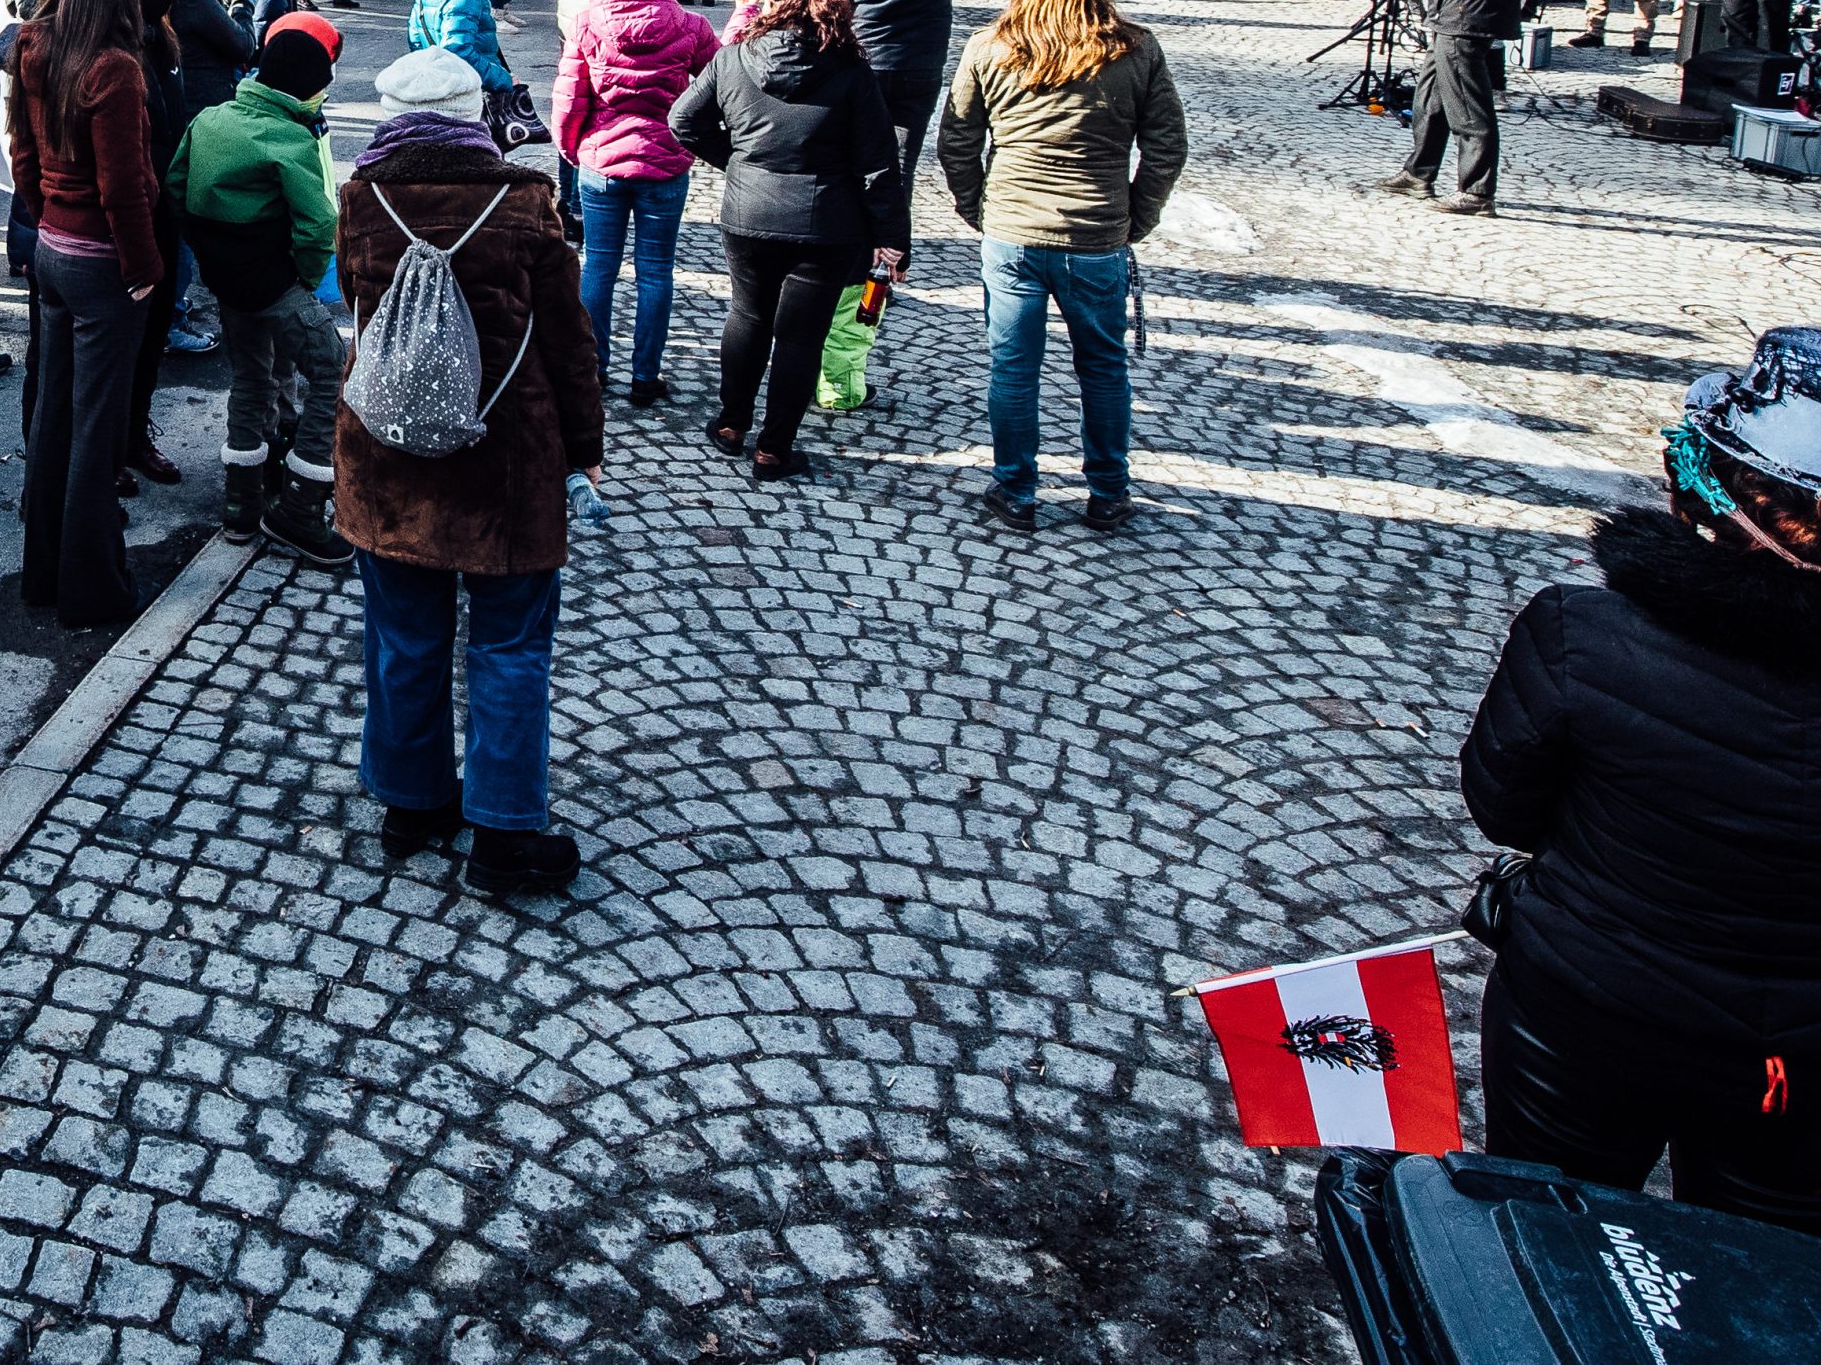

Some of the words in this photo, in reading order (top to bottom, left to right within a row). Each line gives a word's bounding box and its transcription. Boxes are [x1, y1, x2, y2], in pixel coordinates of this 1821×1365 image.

[1598, 1250, 1617, 1269] Die
[1600, 1222, 1682, 1331] bludenz
[1607, 1266, 1648, 1324] Alpenstadt
